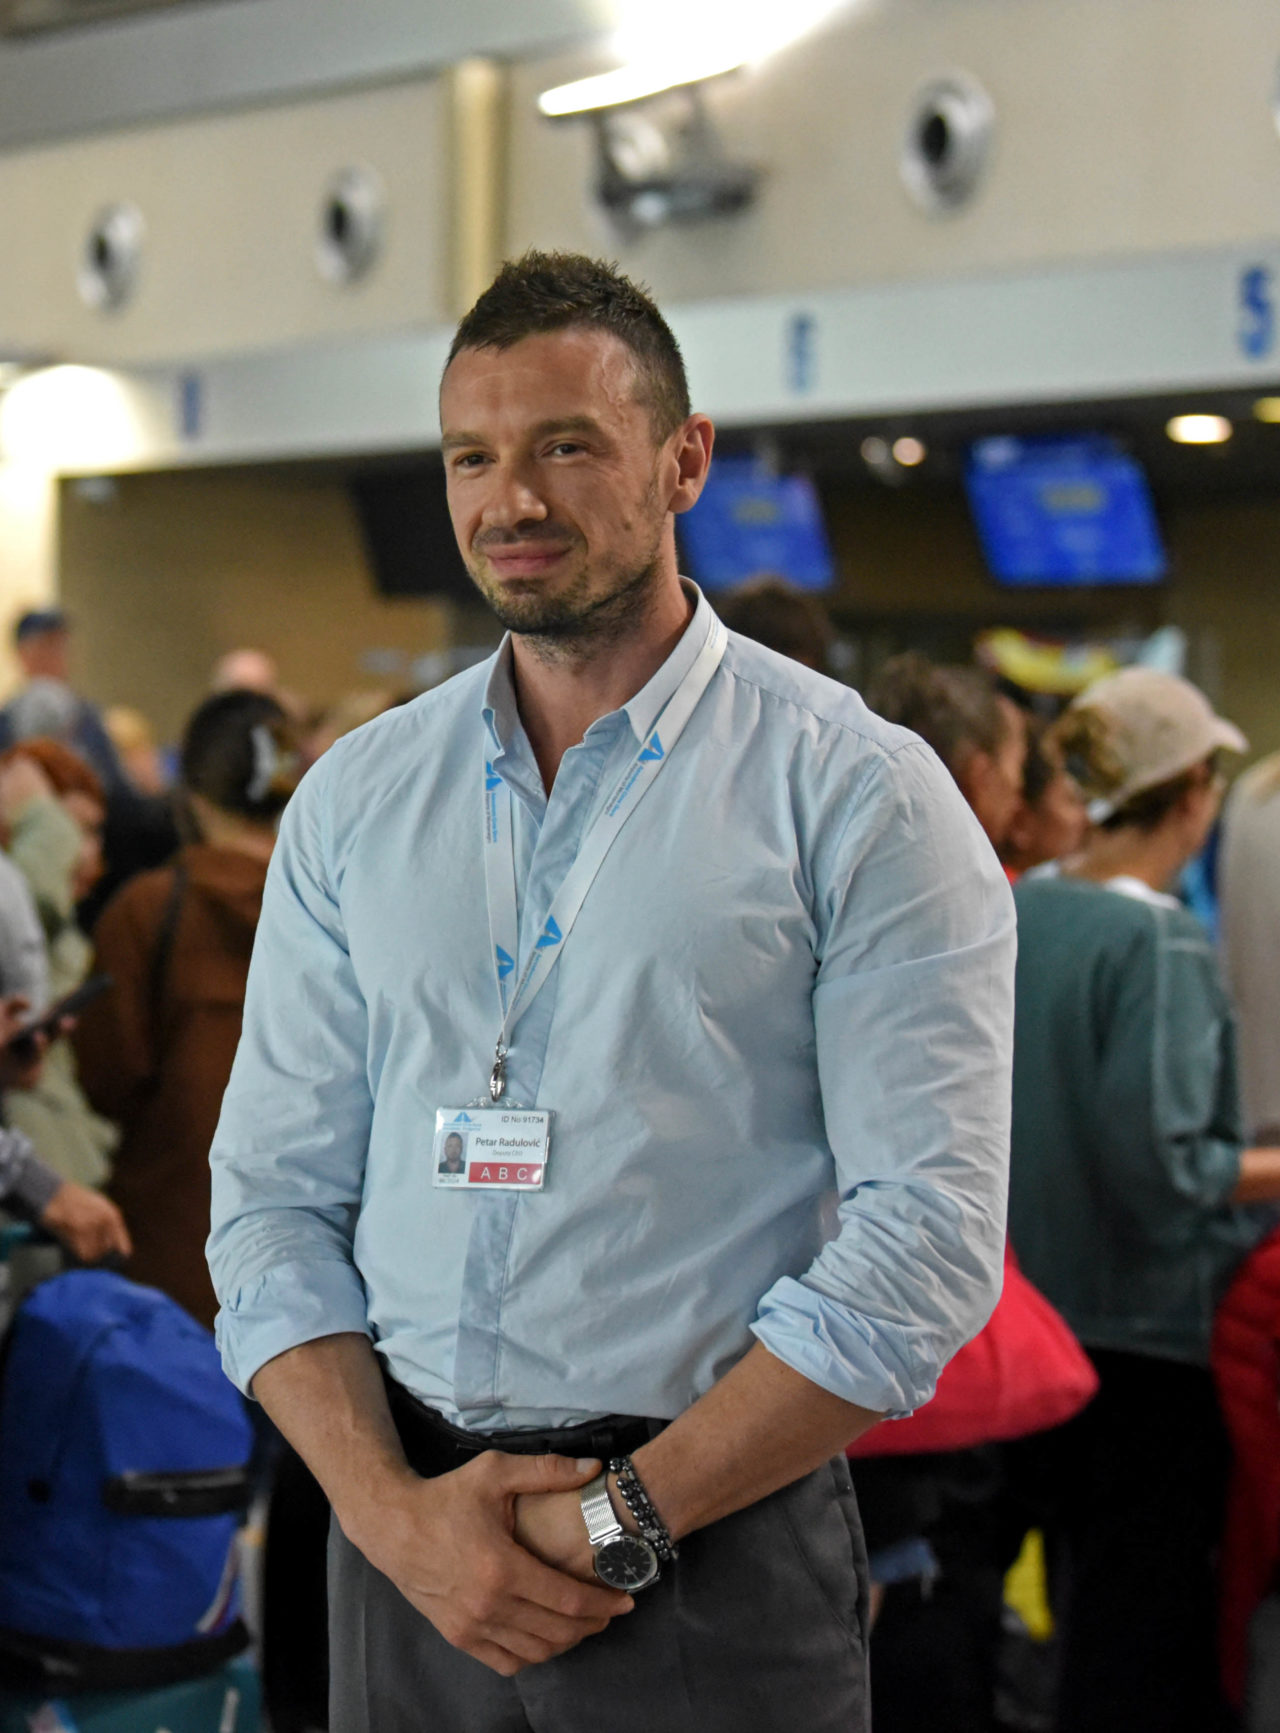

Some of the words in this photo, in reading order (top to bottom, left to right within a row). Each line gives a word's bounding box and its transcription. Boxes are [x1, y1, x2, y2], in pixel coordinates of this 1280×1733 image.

[501, 1115, 510, 1123] ID
[475, 1137, 497, 1147] Petar
[480, 1167, 491, 1180] A
[498, 1167, 508, 1180] B
[517, 1167, 528, 1181] C
